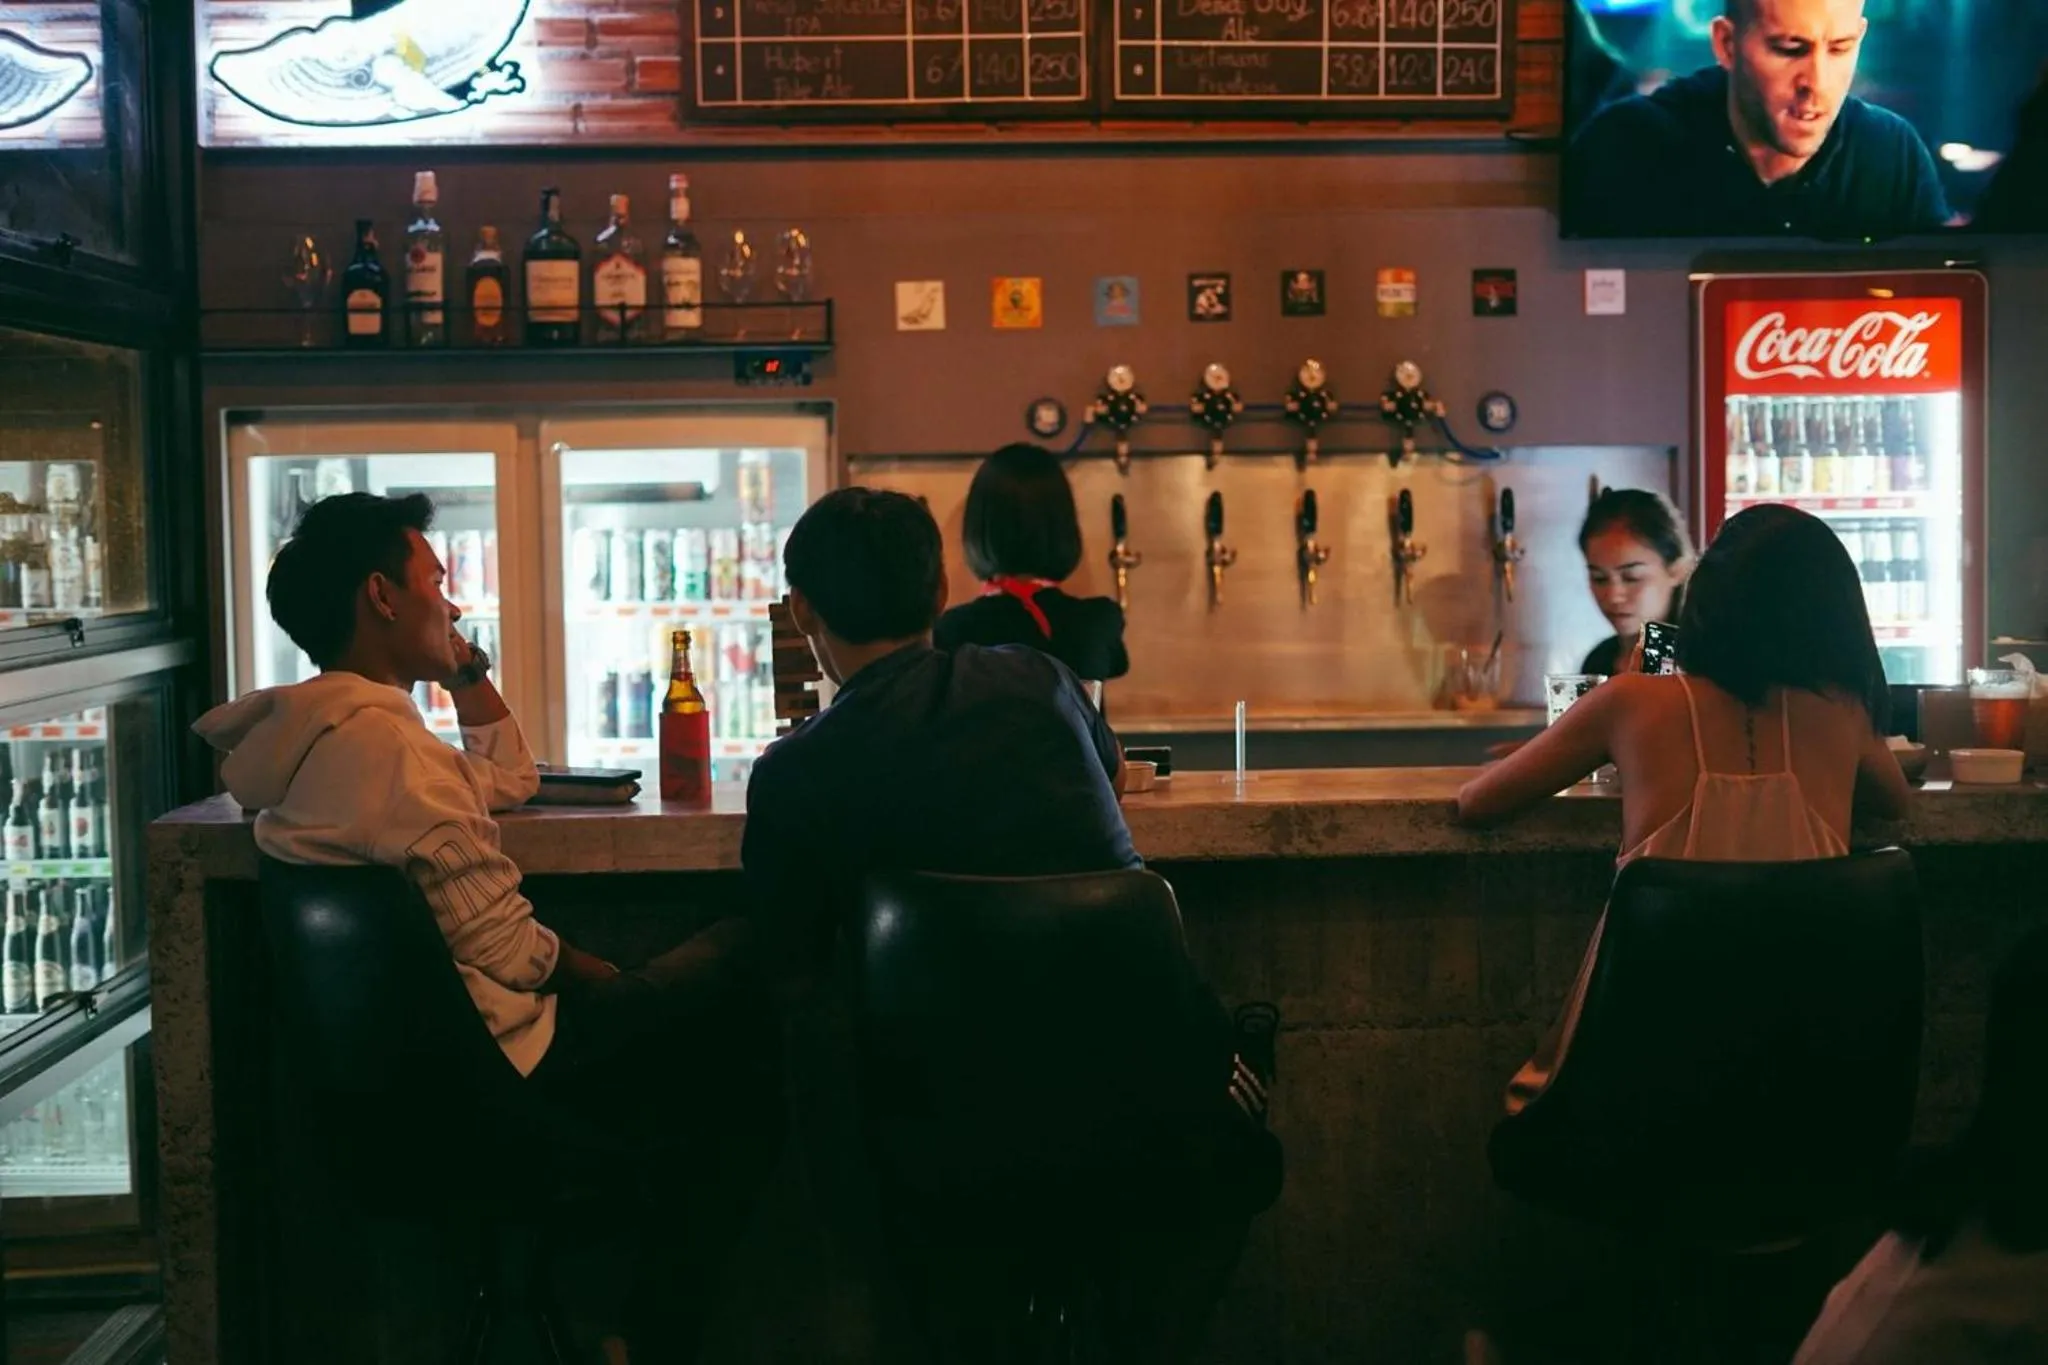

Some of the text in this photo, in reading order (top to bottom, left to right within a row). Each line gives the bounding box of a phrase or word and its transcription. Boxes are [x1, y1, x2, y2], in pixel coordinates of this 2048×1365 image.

[1221, 17, 1261, 41] Ale
[1387, 0, 1437, 29] 140
[1443, 0, 1496, 29] 250
[975, 52, 1020, 85] 140
[1031, 52, 1081, 83] 250
[1444, 54, 1496, 86] 240
[1735, 311, 1941, 379] Coca-Cola
